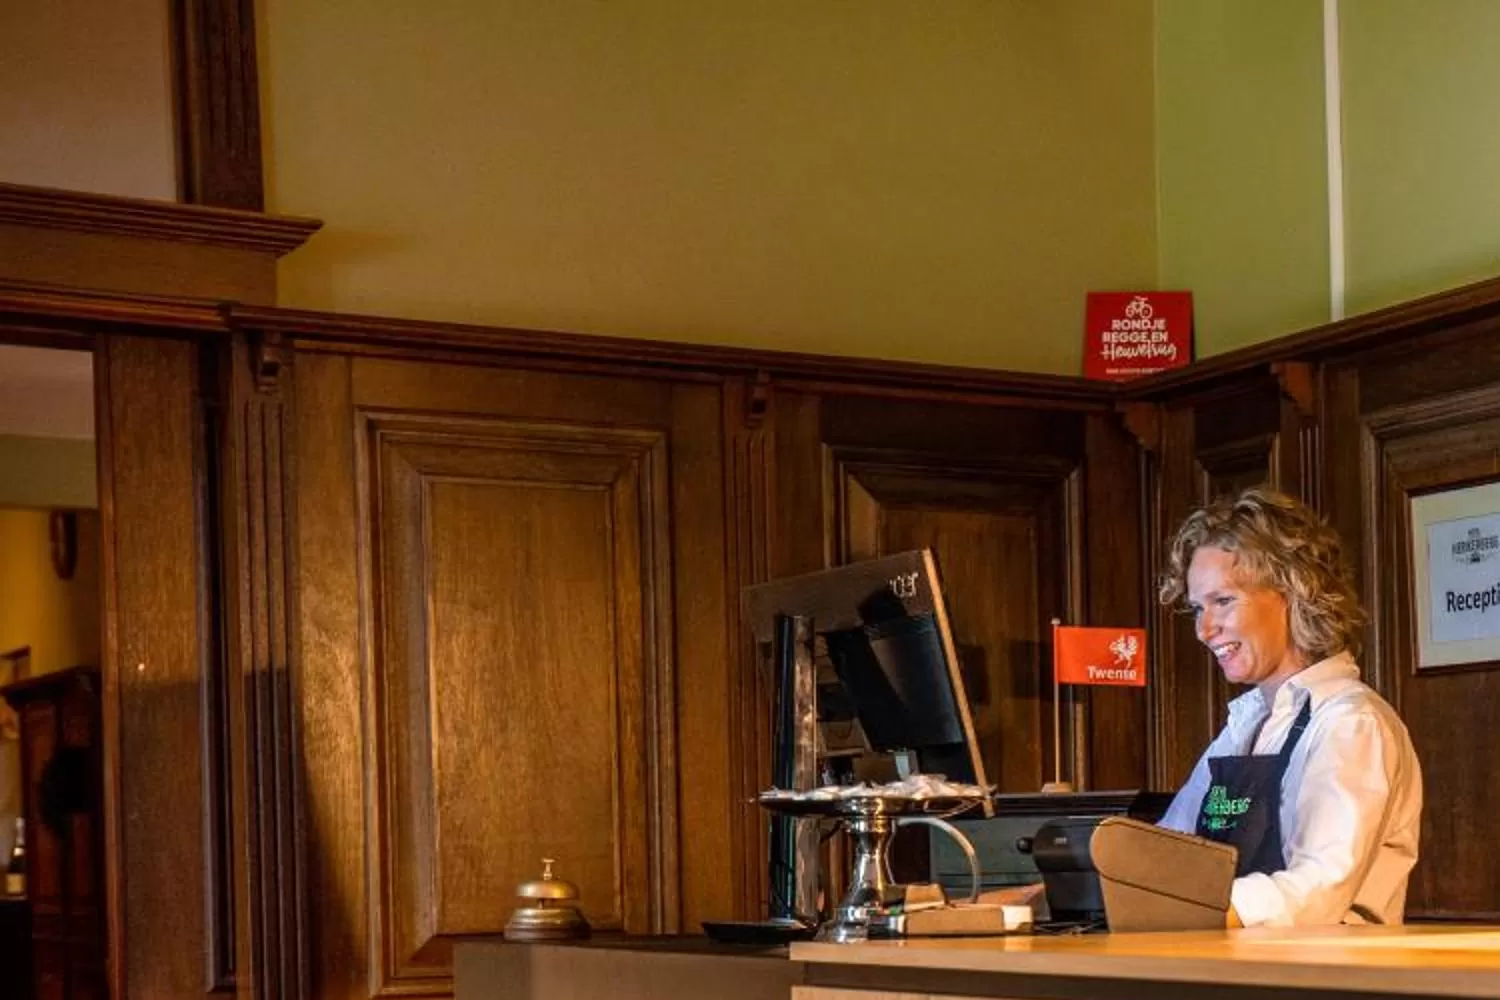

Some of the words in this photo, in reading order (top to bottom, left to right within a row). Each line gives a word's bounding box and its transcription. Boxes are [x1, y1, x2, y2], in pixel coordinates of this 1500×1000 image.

[1111, 319, 1166, 331] RONDJE
[1151, 331, 1169, 343] EN
[1086, 665, 1137, 681] Twente
